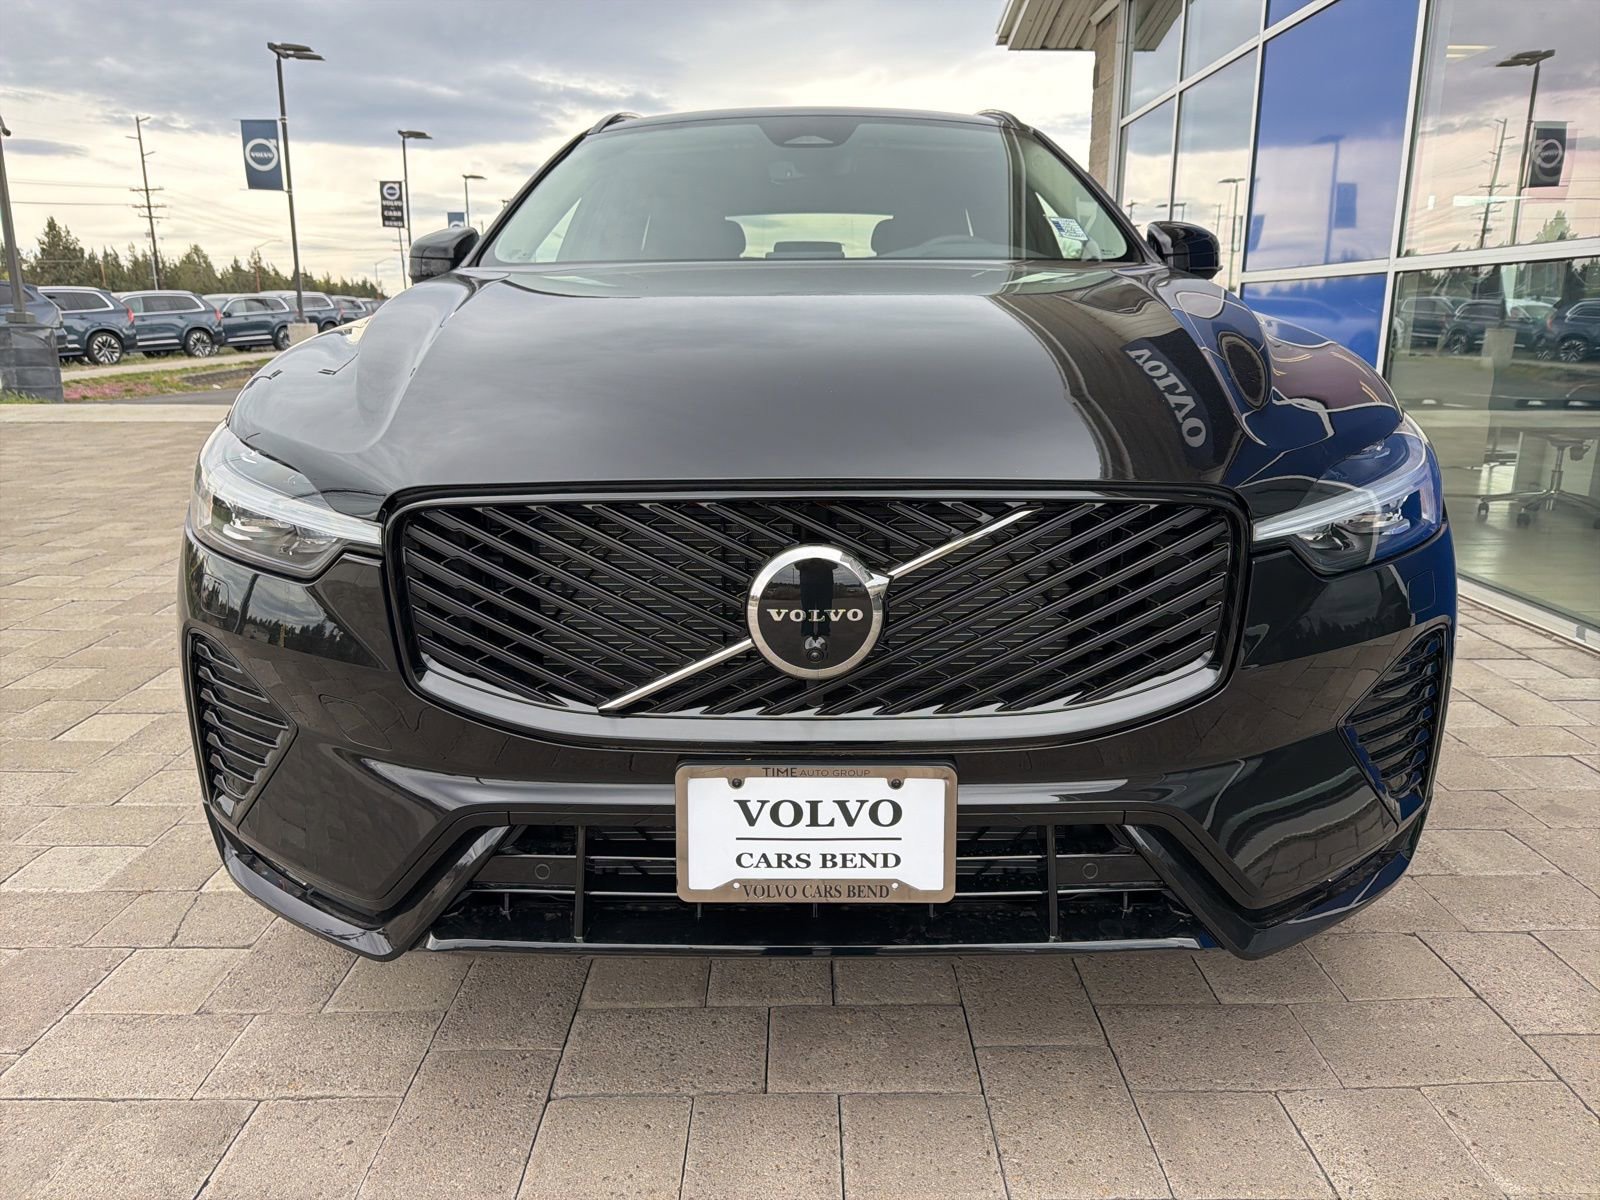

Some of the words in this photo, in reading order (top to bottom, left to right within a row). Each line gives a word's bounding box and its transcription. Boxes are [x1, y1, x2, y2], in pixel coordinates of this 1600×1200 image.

[767, 608, 863, 622] VOLVO
[762, 767, 797, 777] TIME
[800, 769, 829, 777] AUTO
[832, 769, 871, 777] GROUP
[733, 799, 903, 828] VOLVO
[735, 852, 811, 869] CARS
[819, 852, 901, 869] BEND
[742, 884, 797, 899] VOLVO
[802, 884, 842, 899] CARS
[846, 885, 890, 898] BEND
